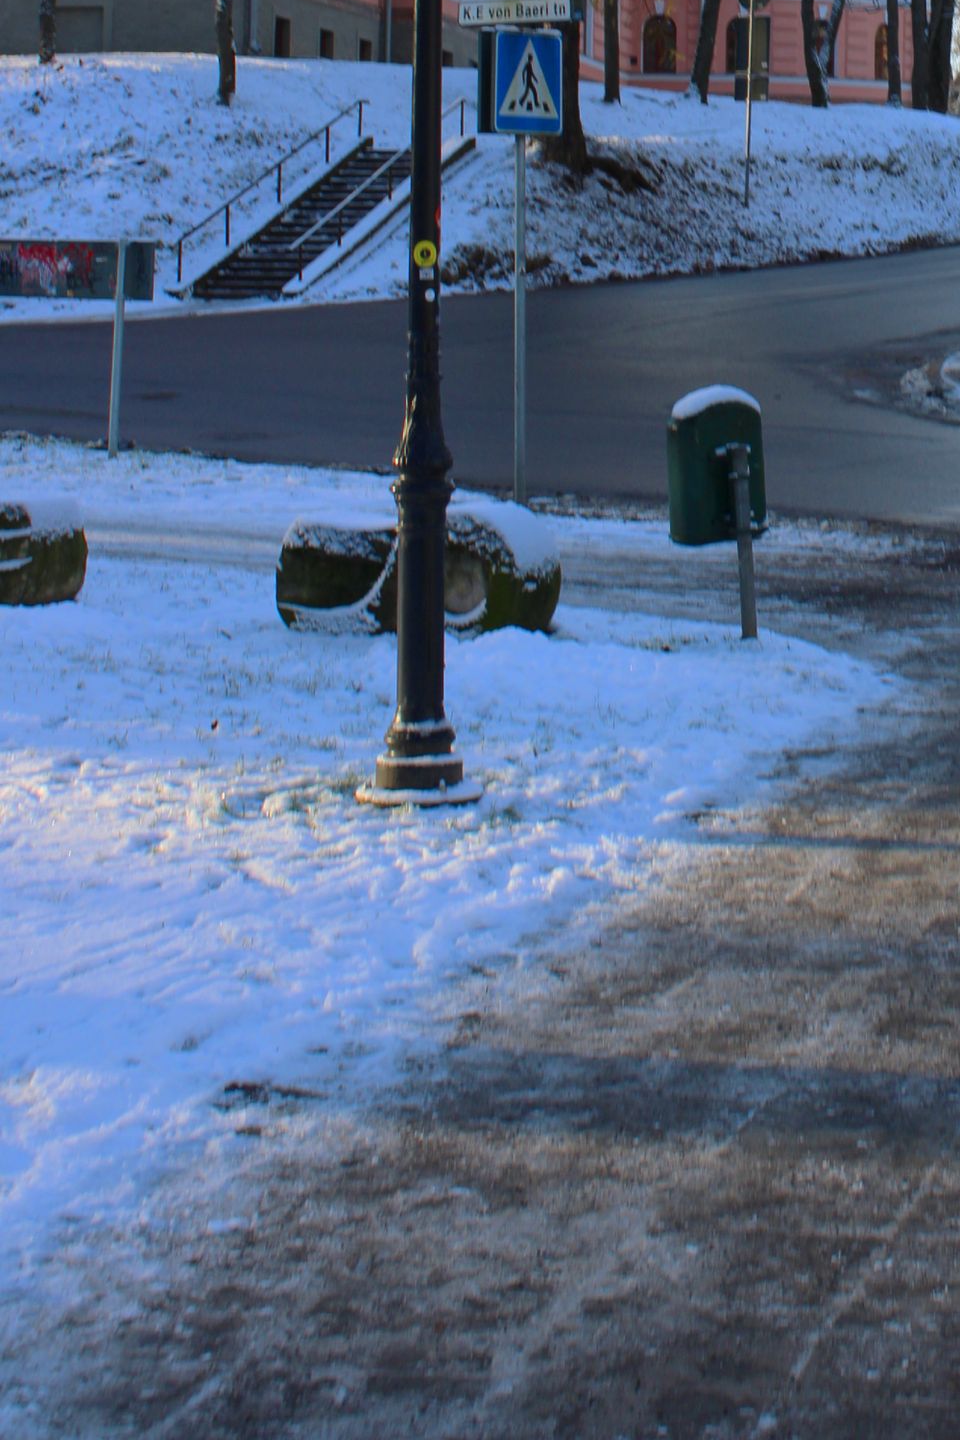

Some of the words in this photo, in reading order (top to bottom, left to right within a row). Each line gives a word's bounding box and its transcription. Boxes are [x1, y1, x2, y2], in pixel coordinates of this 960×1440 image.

[488, 6, 511, 19] von
[515, 2, 549, 18] Baeri
[553, 2, 566, 17] tn
